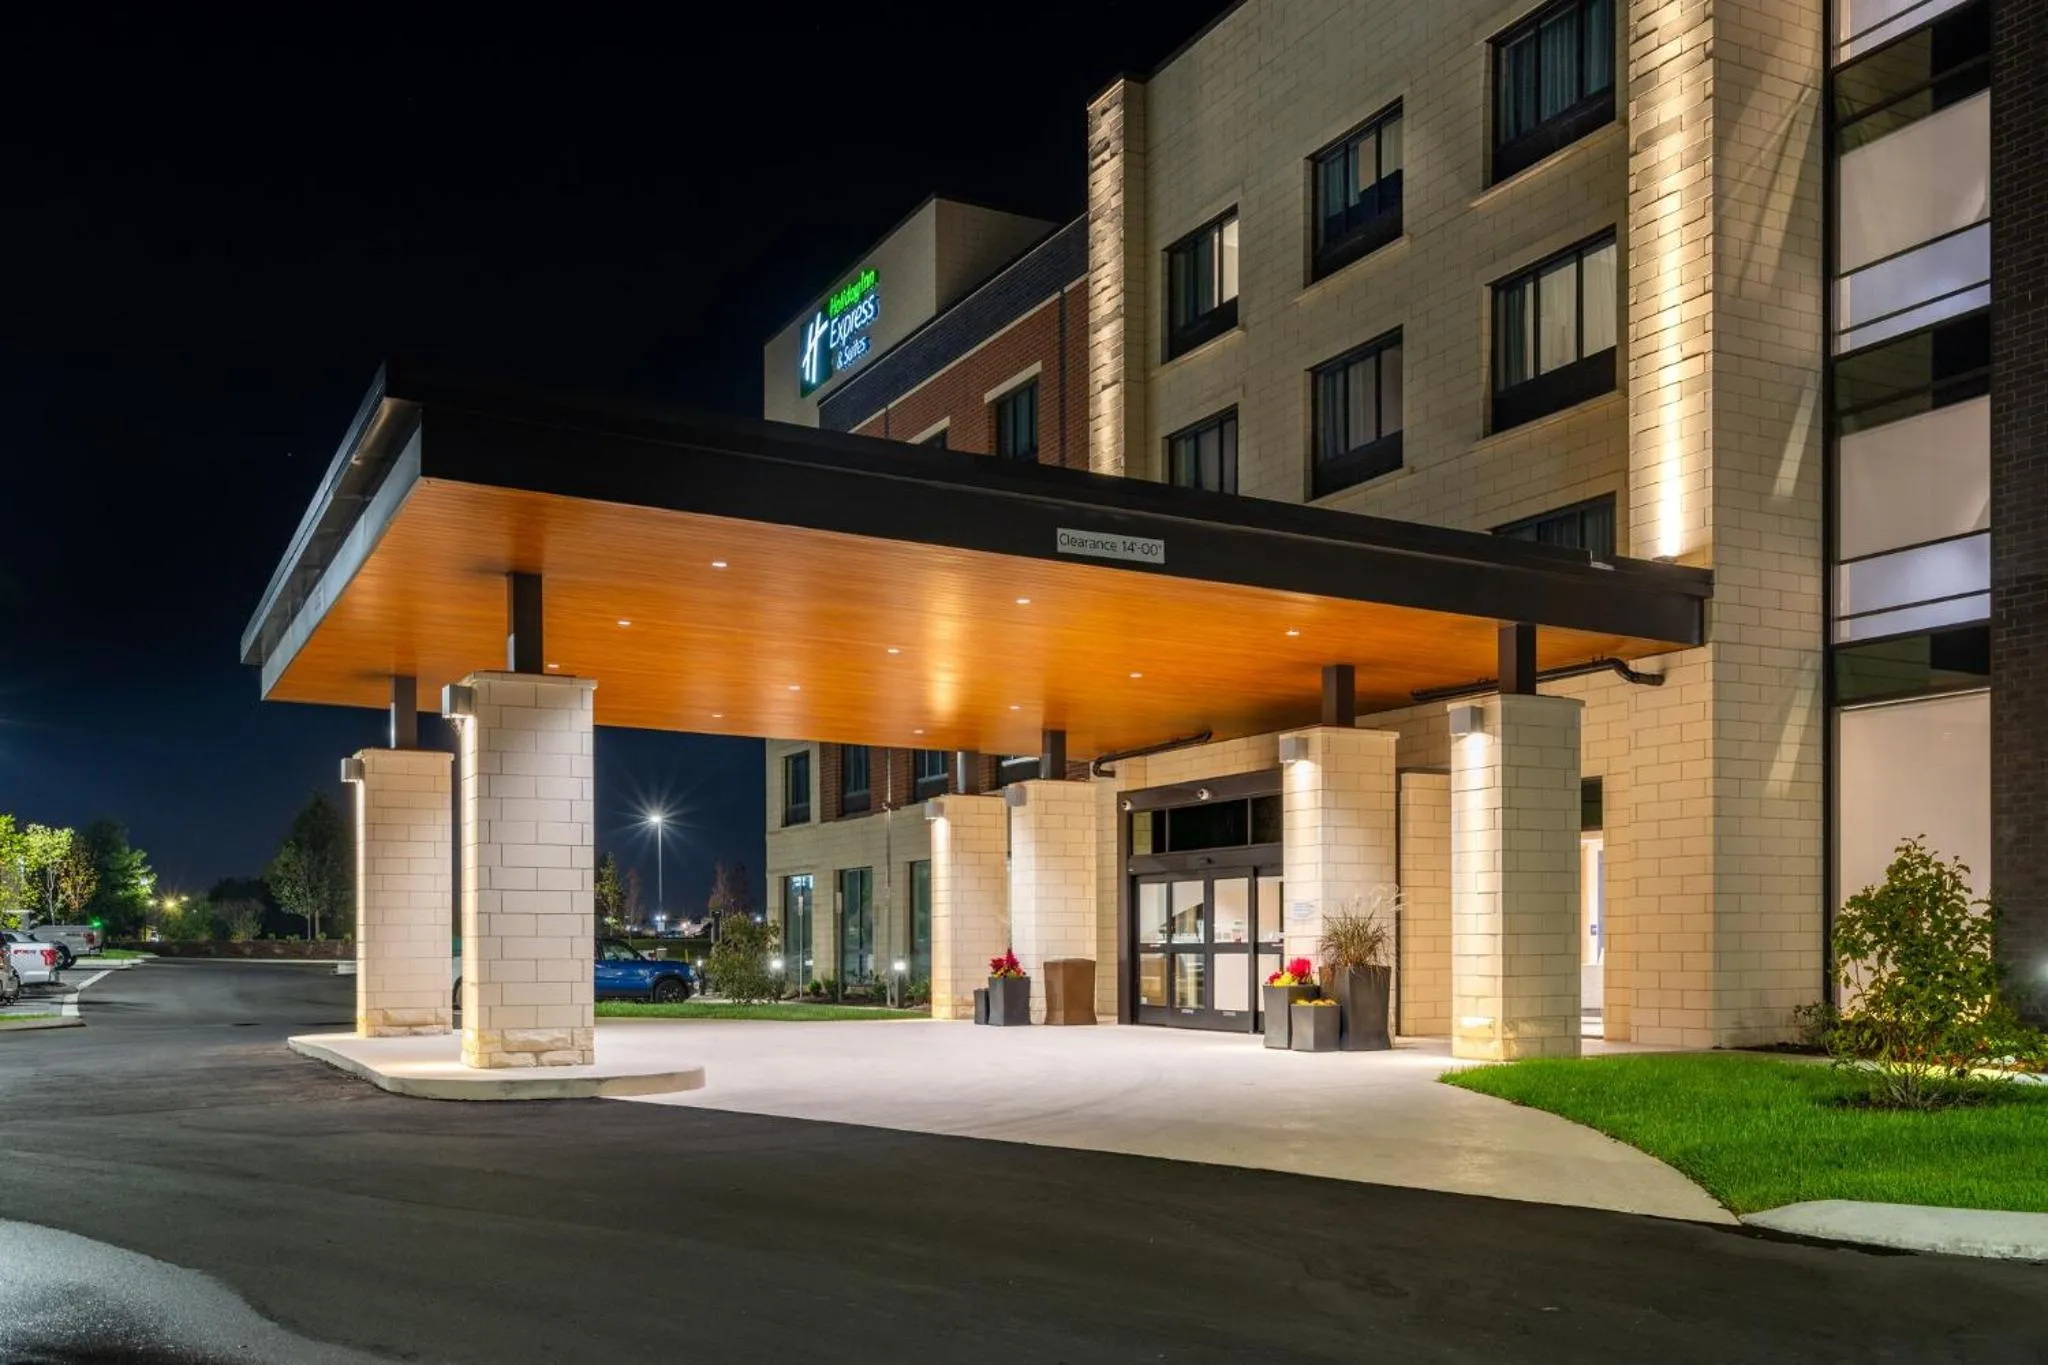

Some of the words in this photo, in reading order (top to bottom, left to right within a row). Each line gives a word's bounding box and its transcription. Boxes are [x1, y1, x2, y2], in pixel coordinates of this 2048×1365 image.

[830, 294, 875, 349] Express
[844, 336, 867, 365] Suites
[1059, 533, 1118, 552] Clearance
